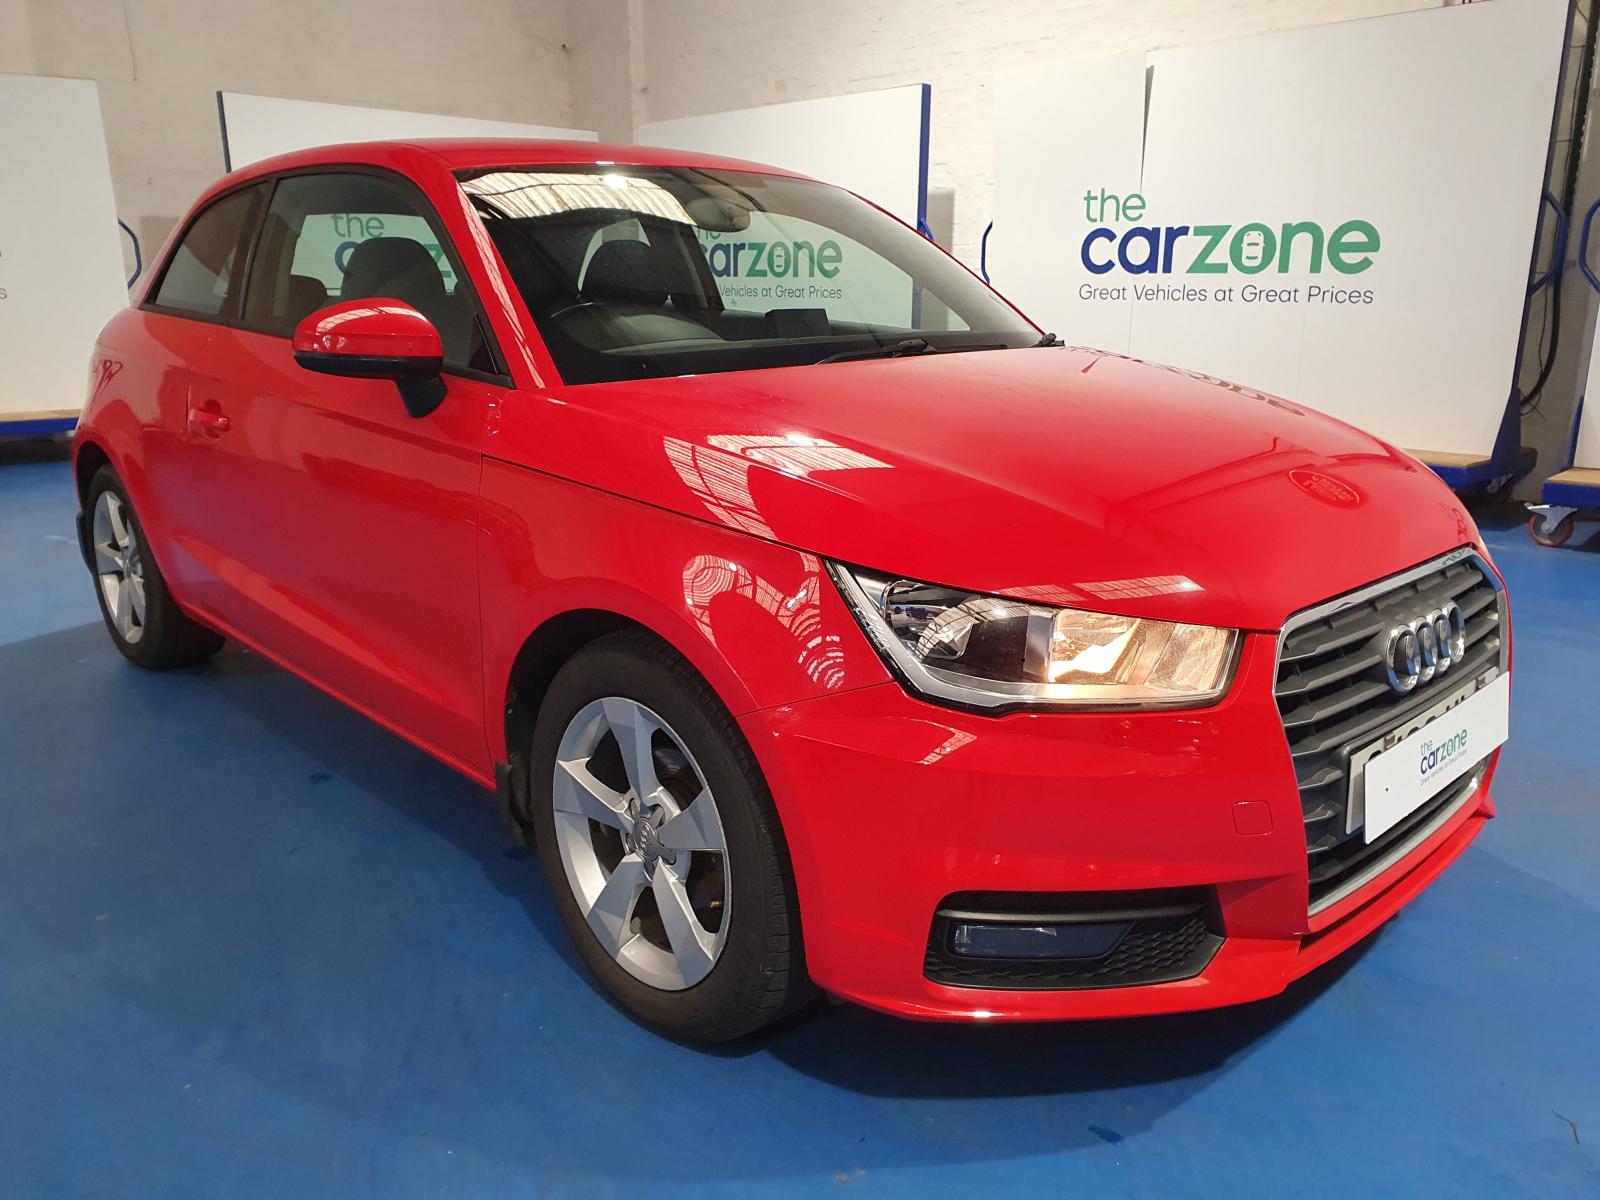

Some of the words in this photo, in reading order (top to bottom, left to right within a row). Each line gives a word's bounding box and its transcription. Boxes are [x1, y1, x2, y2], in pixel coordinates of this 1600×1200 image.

[1083, 187, 1146, 223] the
[330, 213, 385, 238] the
[1080, 219, 1381, 275] carzone
[720, 284, 758, 297] Vehicles
[761, 286, 772, 297] at
[775, 284, 805, 298] Great
[808, 285, 842, 299] Prices
[1078, 283, 1127, 301] Great
[1133, 284, 1208, 302] Vehicles
[1214, 286, 1234, 302] at
[1241, 284, 1300, 303] Great
[1307, 285, 1375, 304] Prices
[1420, 740, 1433, 756] the
[1420, 728, 1468, 775] carzone
